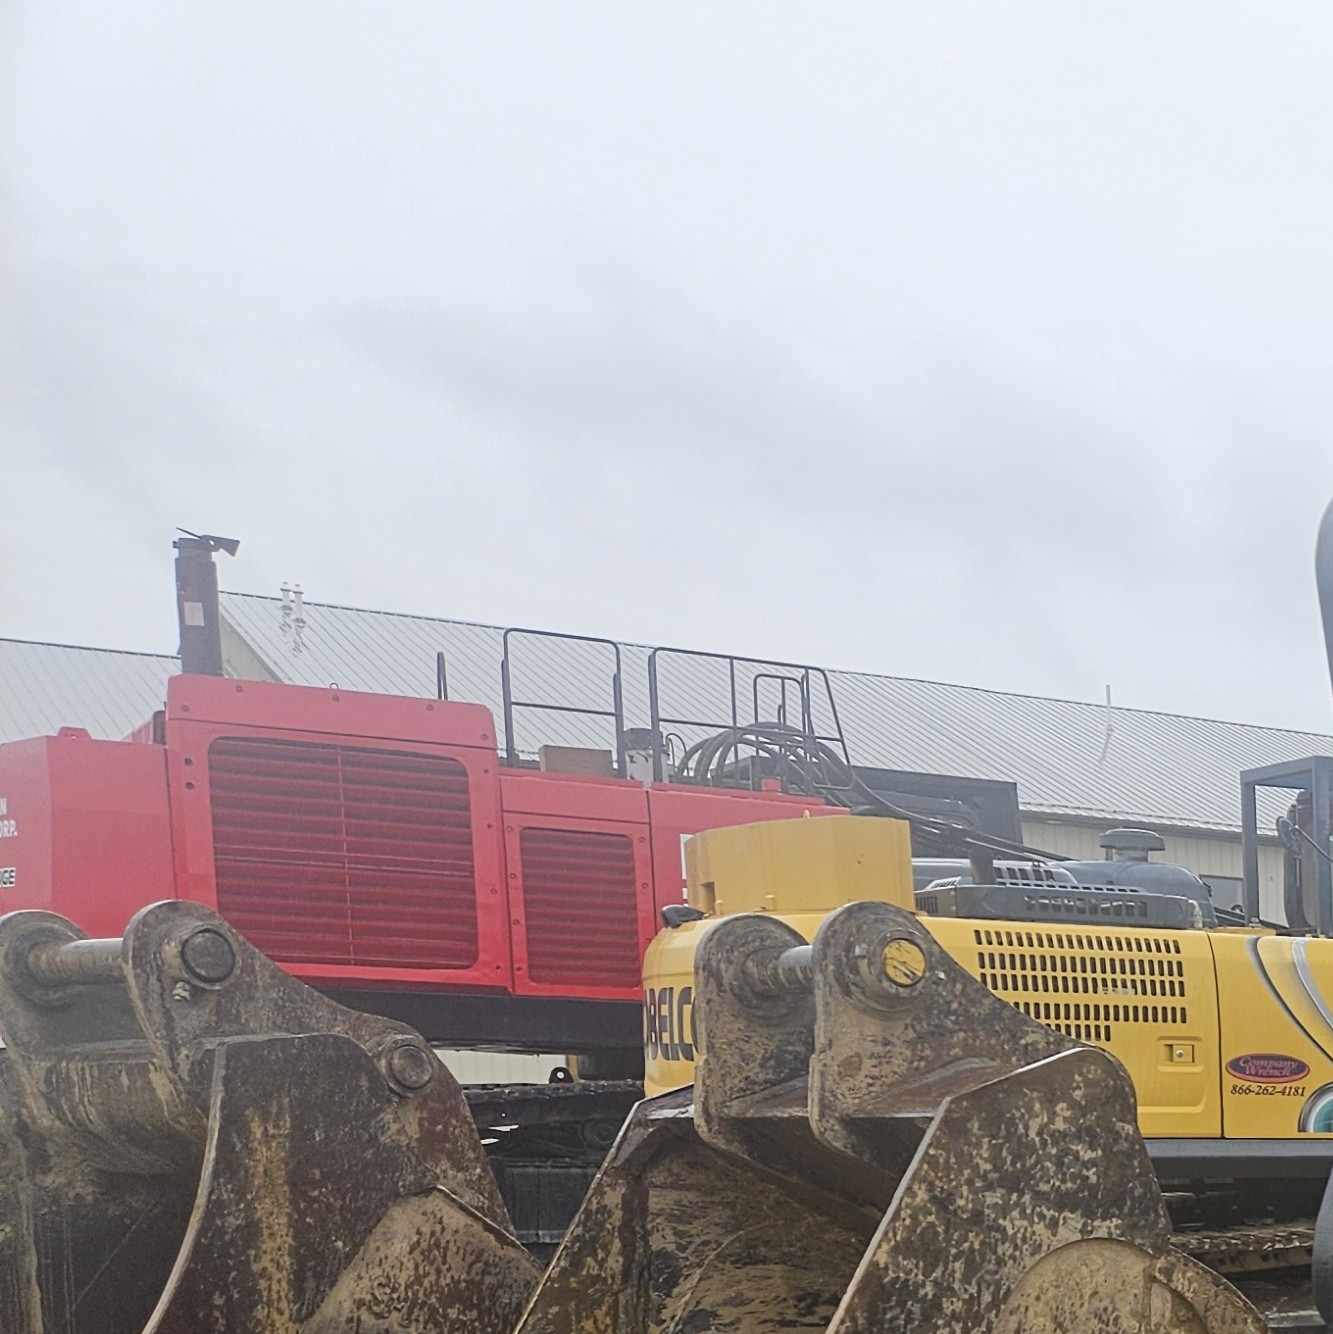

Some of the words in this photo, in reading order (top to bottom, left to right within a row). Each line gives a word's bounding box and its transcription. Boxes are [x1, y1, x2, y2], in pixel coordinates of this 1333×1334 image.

[645, 986, 699, 1062] BELC
[1240, 1056, 1298, 1068] Company
[1230, 1084, 1306, 1097] 866-262-4181
